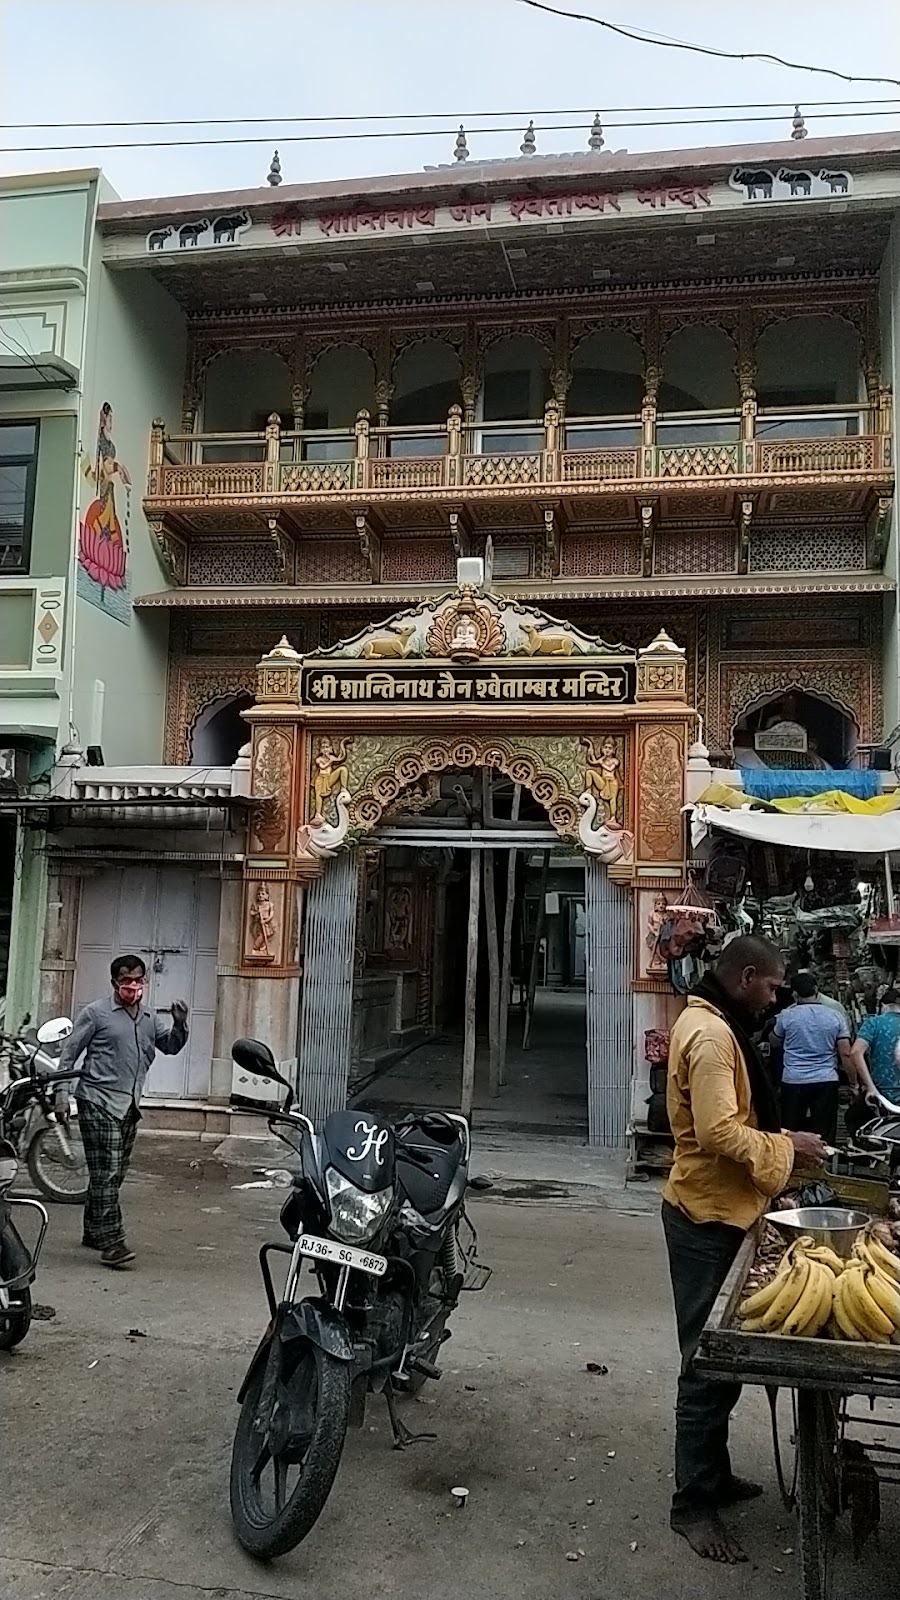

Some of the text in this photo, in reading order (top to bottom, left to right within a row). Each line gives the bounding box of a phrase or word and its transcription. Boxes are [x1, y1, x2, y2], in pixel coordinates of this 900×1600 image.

[311, 670, 623, 699] श्री शान्तिनाथ जैन श्वेताम्बर मन्दिर
[338, 1249, 353, 1263] SG
